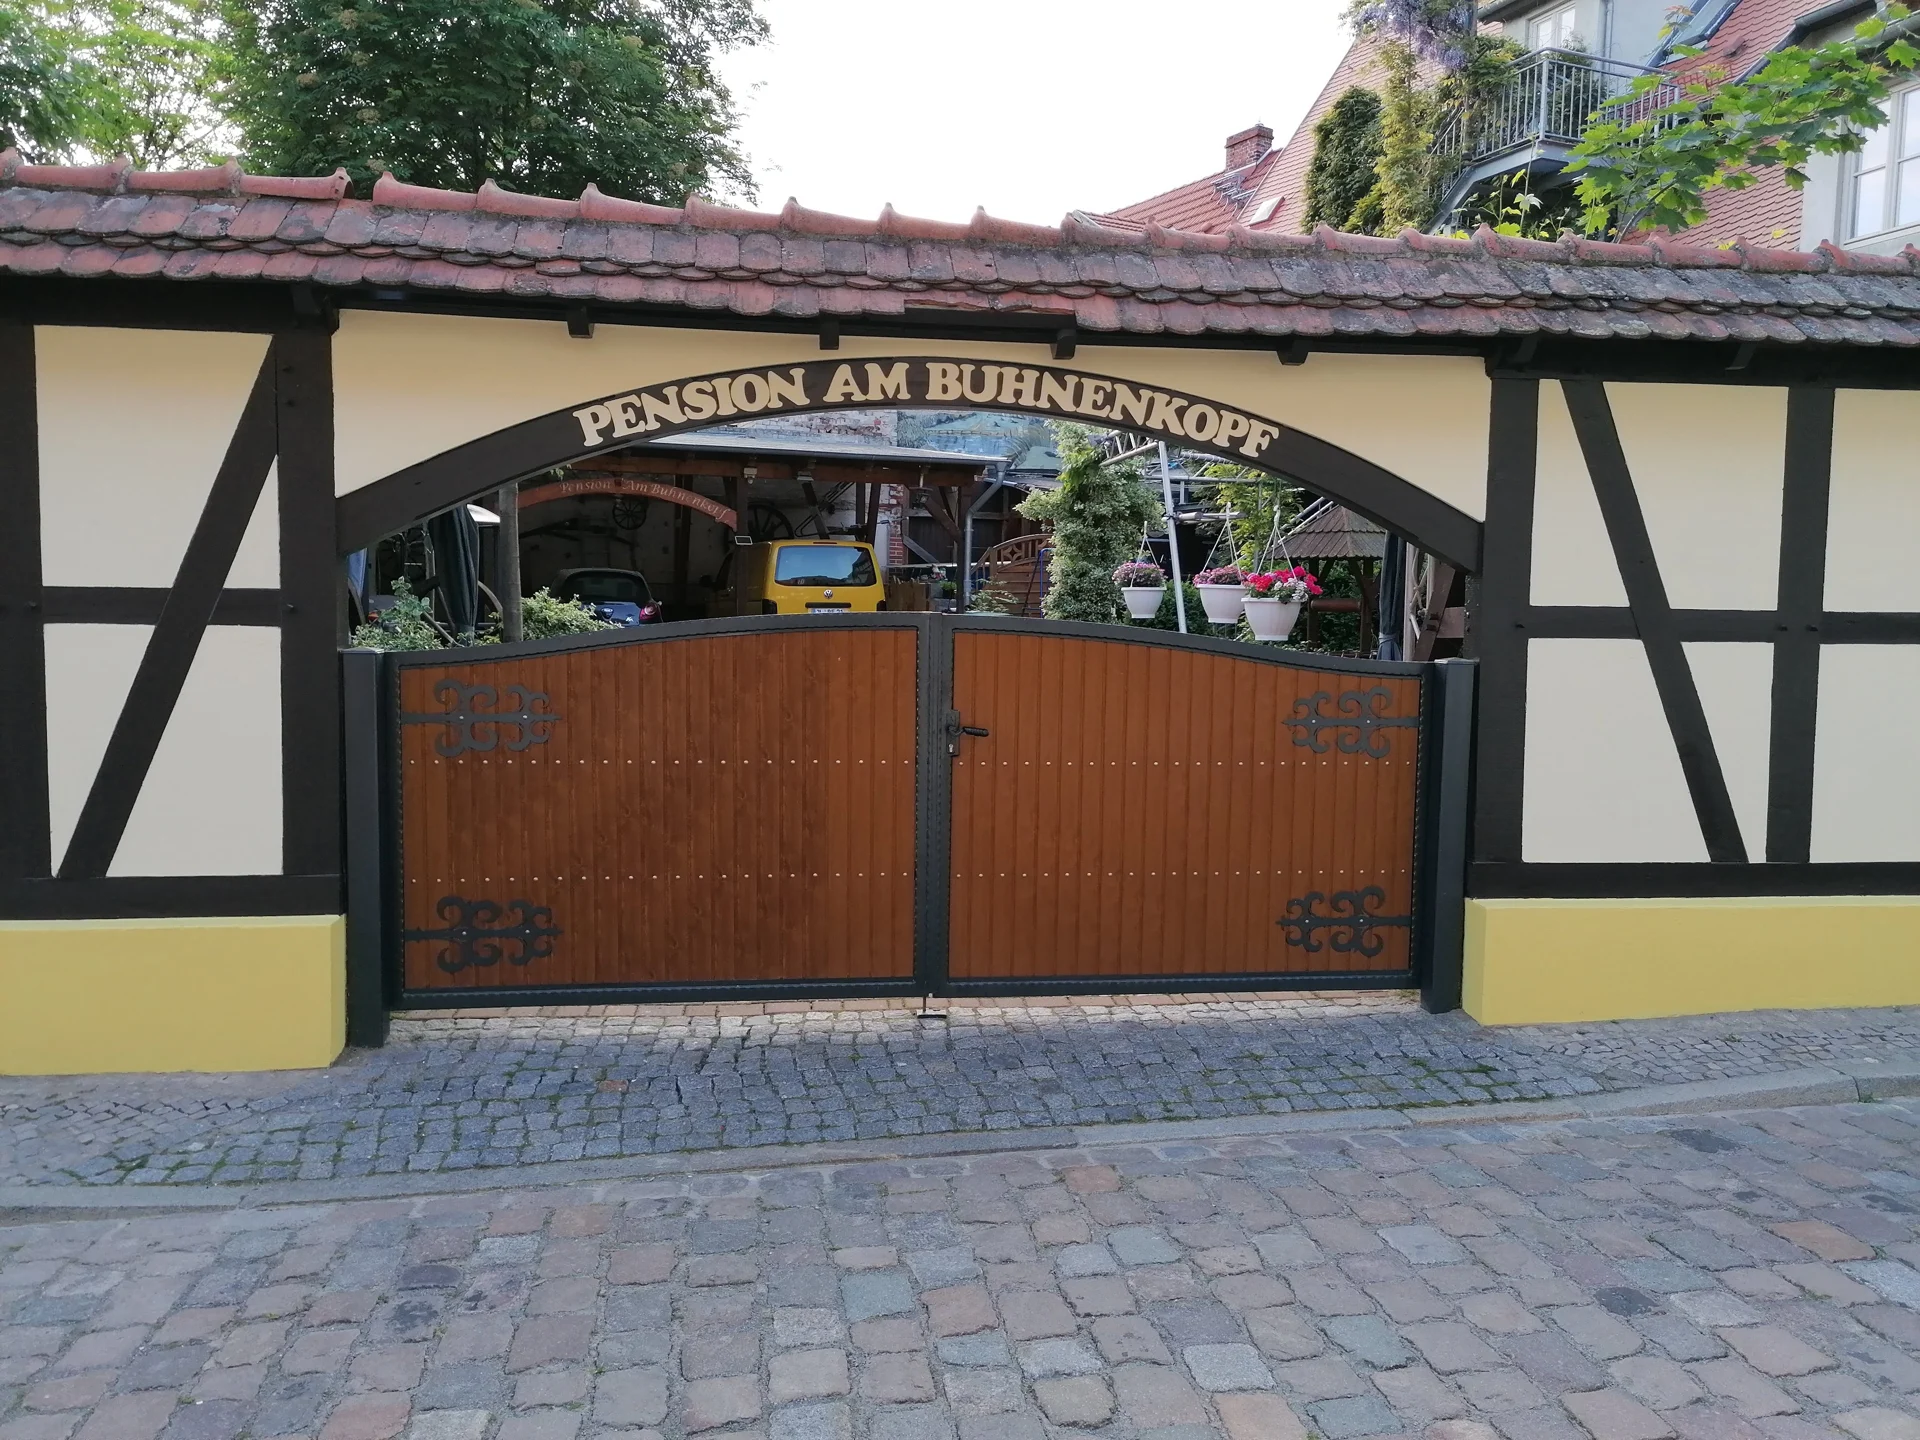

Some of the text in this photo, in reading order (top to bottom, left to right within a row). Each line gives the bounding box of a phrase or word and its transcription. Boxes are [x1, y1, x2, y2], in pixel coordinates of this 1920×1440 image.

[573, 362, 1280, 458] PENSION AM BUHNENKOPF
[560, 480, 611, 493] Pension
[621, 478, 648, 493] Am
